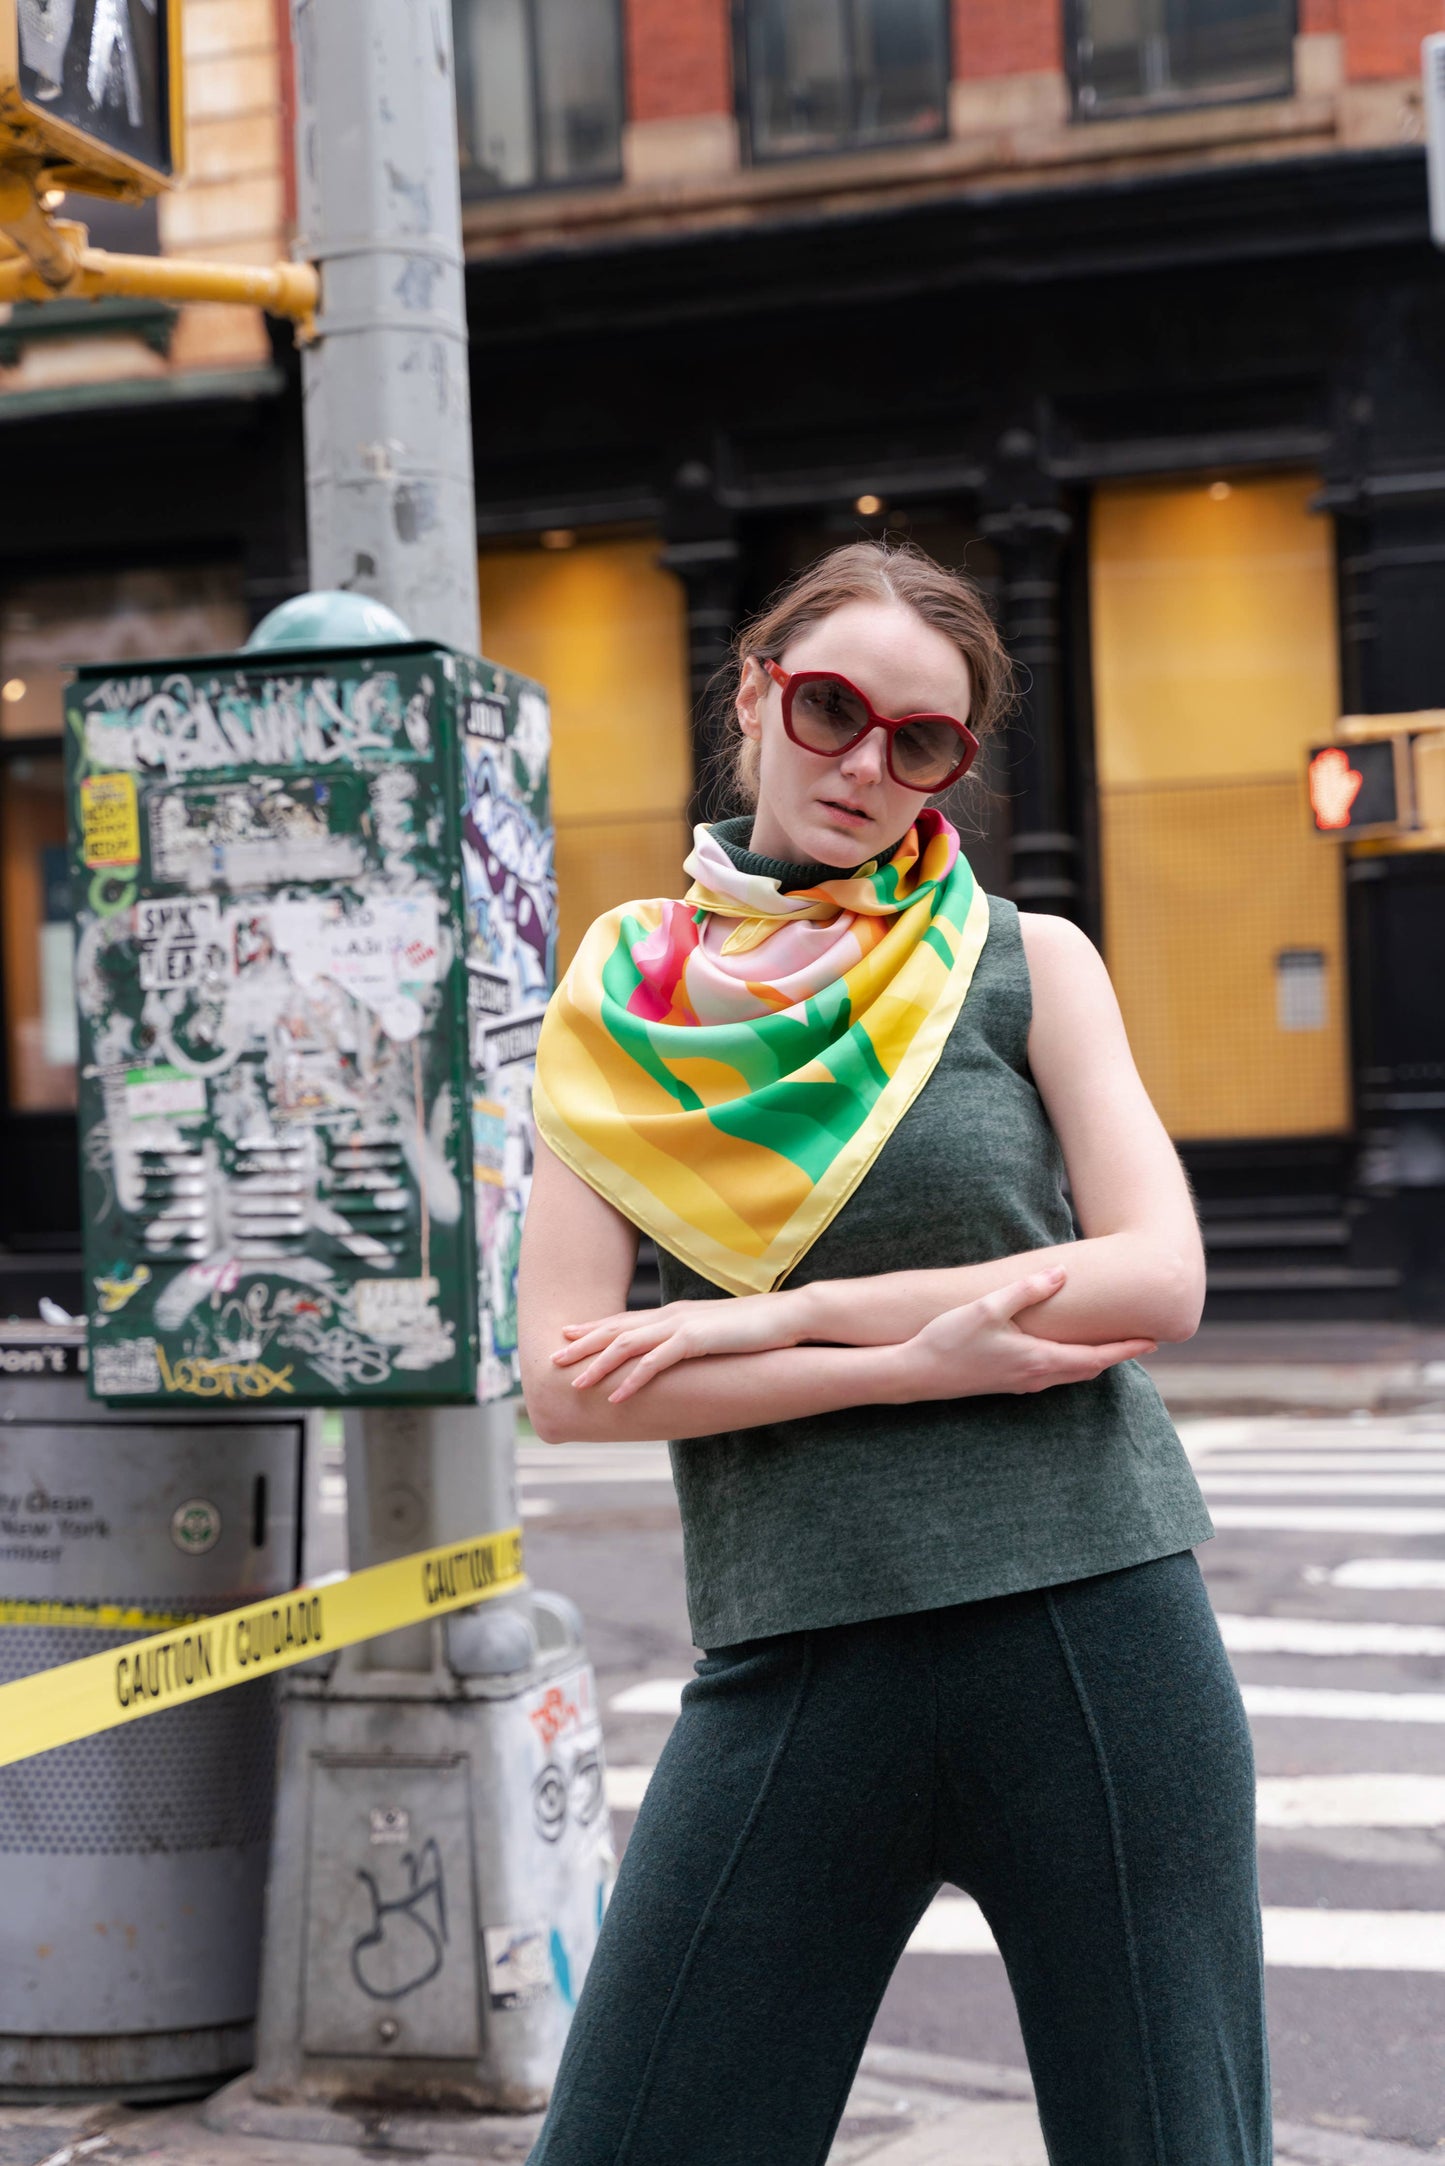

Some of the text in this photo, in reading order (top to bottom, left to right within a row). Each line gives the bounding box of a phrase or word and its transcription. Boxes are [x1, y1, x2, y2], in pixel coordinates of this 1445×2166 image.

[0, 1345, 68, 1372] on't
[116, 1630, 213, 1707] CAUTION
[236, 1596, 322, 1666] CUIDADO
